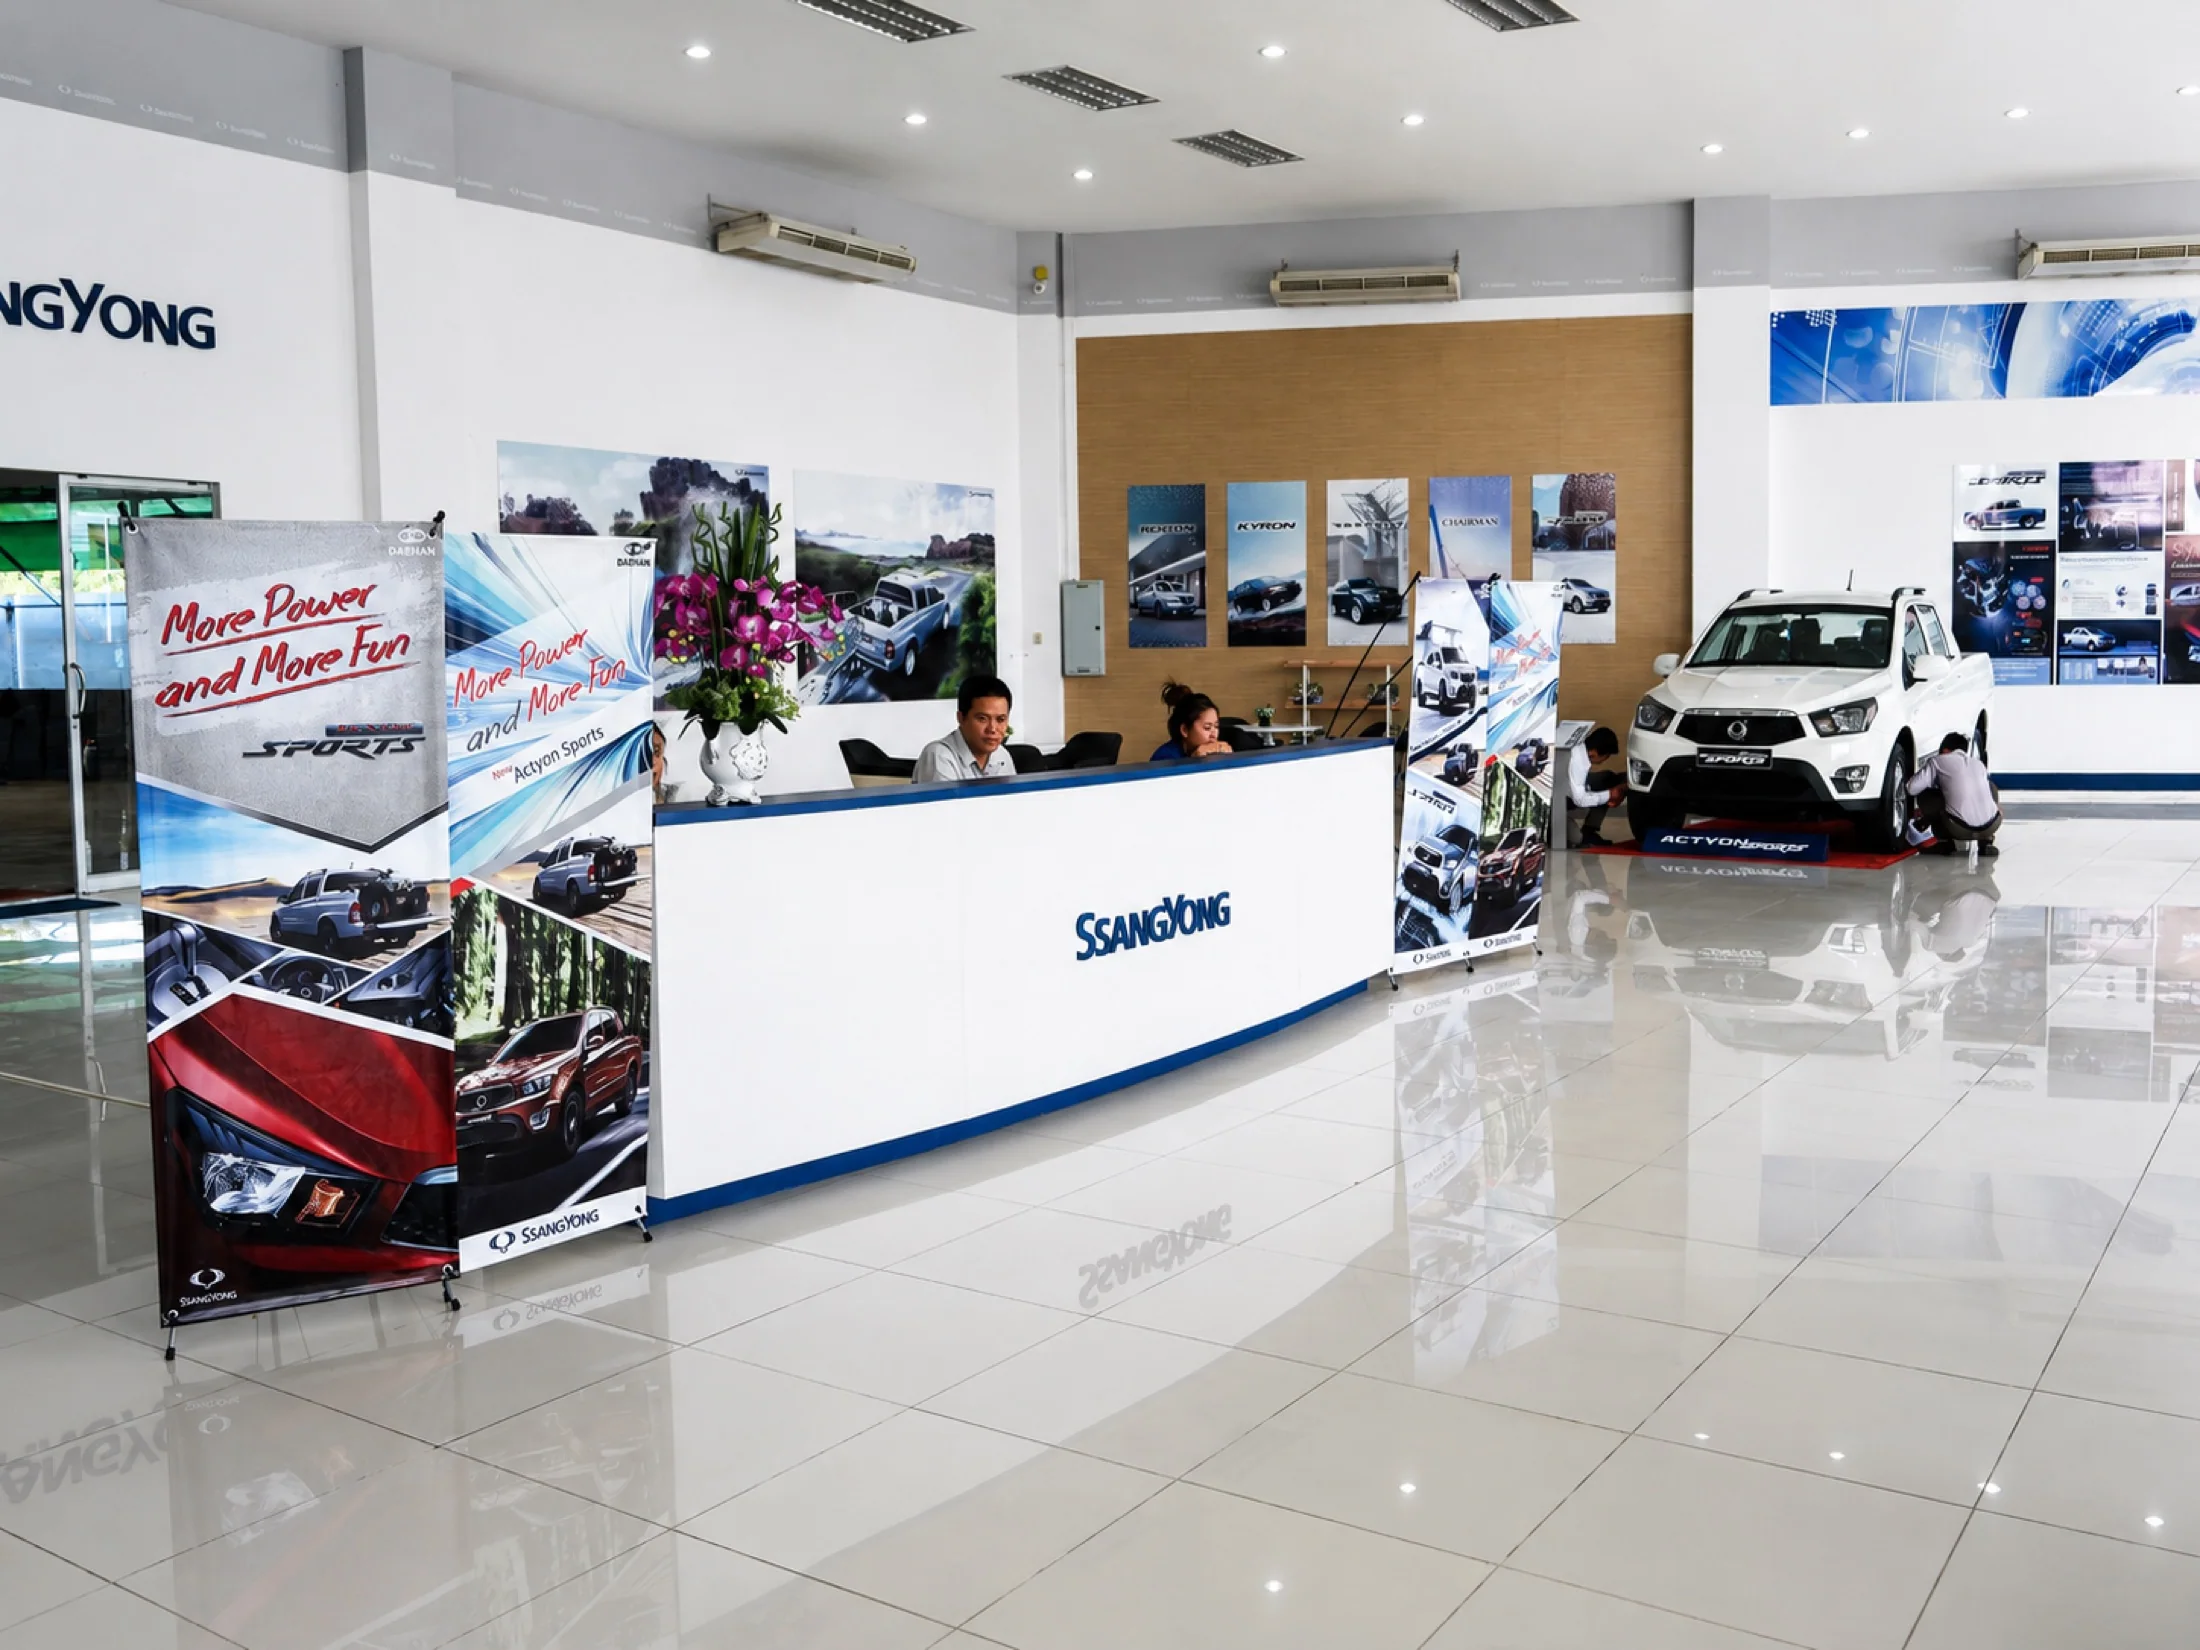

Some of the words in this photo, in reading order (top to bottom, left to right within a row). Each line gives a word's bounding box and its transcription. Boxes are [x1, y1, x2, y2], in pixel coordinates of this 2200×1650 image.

[1237, 521, 1297, 532] KYRON
[1441, 517, 1499, 528] CHAIRMAN
[161, 601, 256, 646] More
[262, 583, 378, 627] Power
[154, 656, 247, 707] and
[251, 640, 343, 686] More
[348, 623, 411, 668] Fun
[453, 667, 512, 708] More
[519, 628, 589, 679] Power
[467, 699, 522, 752] and
[527, 683, 583, 722] More
[588, 655, 627, 693] Fun
[242, 736, 427, 760] SPORTS
[491, 765, 513, 781] New
[513, 748, 560, 784] Actyon
[561, 726, 605, 761] Sports
[1660, 835, 1749, 847] ACTYON
